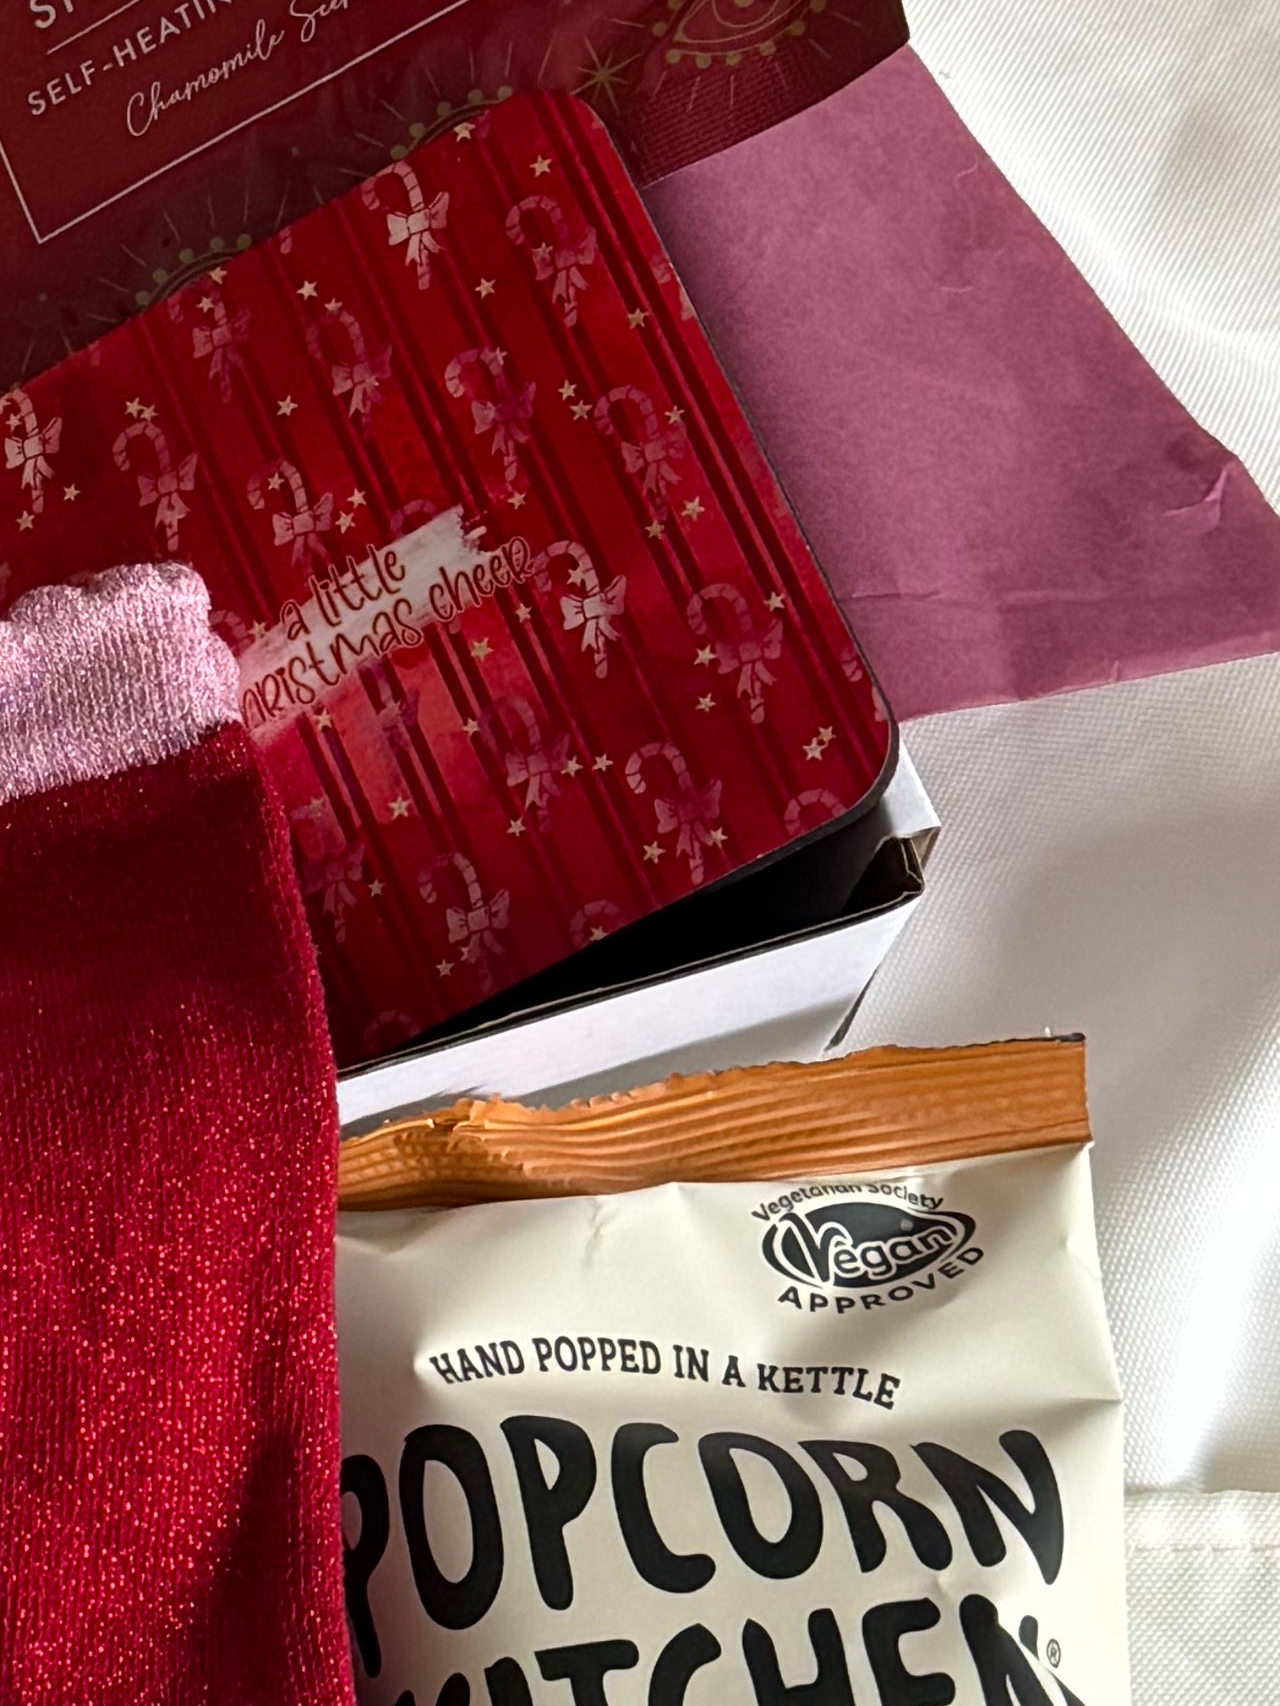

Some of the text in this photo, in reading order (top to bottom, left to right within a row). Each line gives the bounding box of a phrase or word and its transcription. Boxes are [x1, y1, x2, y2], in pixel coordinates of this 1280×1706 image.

[126, 20, 285, 137] Chamomile
[281, 544, 406, 641] a little
[751, 1185, 944, 1222] Vegetarian Society
[777, 1247, 985, 1314] APPROVED
[779, 1212, 958, 1283] Vegan
[429, 1337, 901, 1411] HAND POPPED IN A KETTLE
[341, 1415, 1064, 1678] POPCORN
